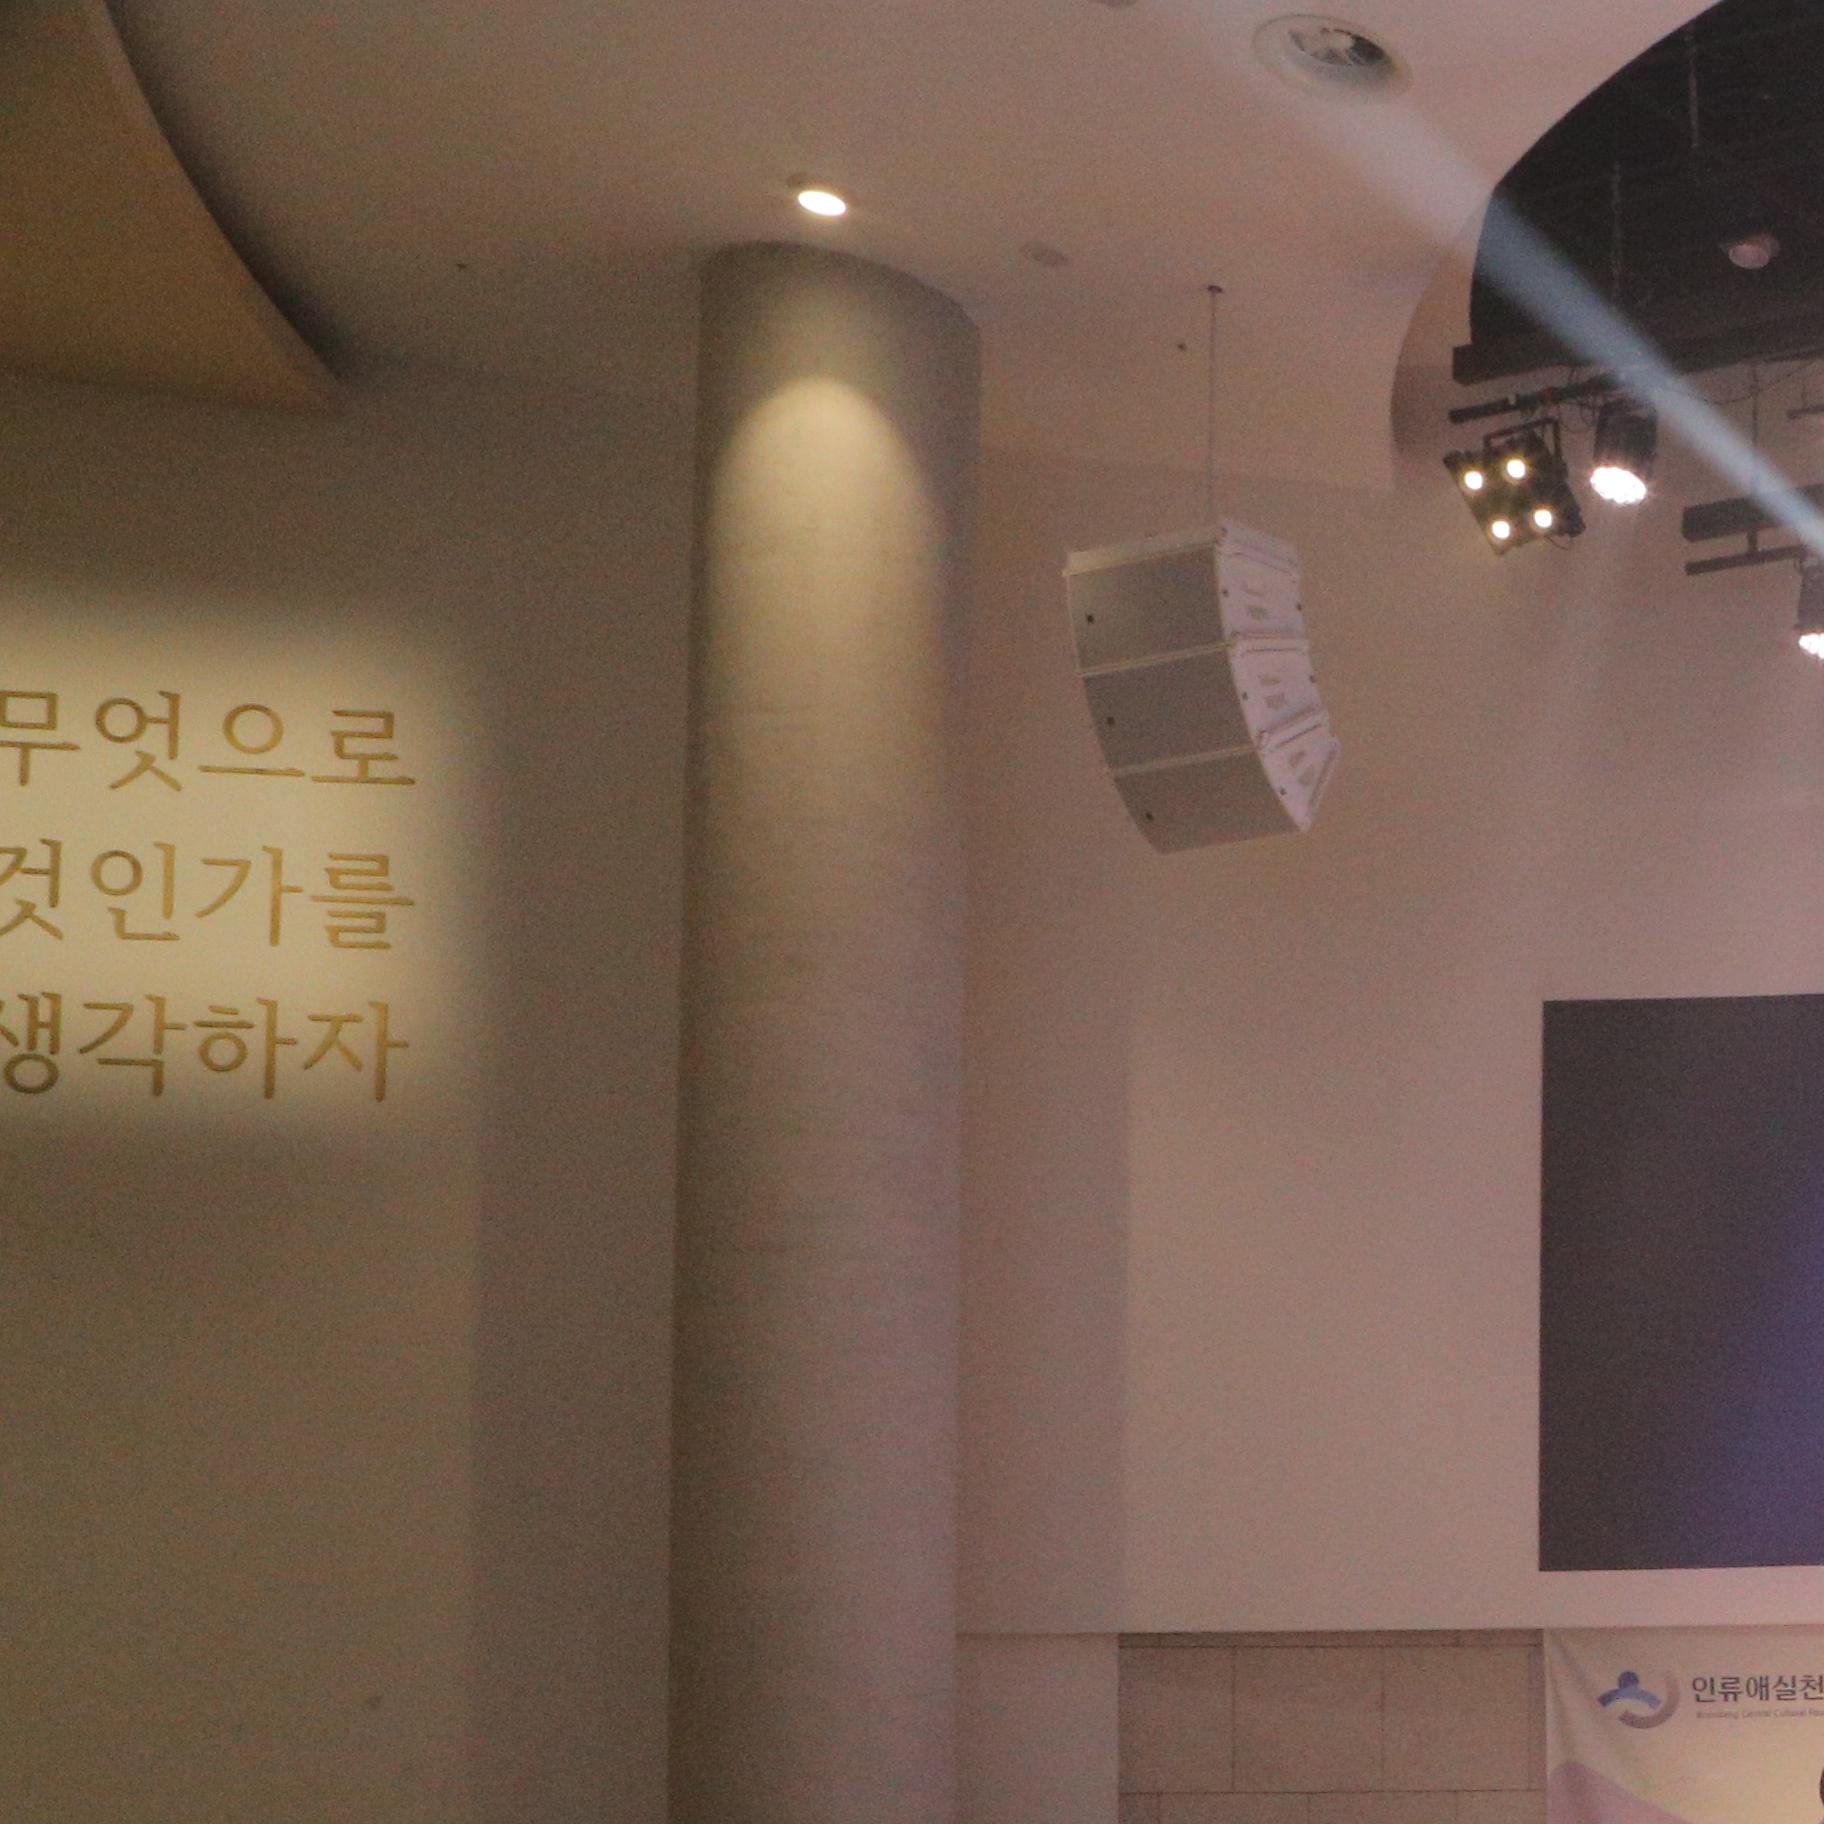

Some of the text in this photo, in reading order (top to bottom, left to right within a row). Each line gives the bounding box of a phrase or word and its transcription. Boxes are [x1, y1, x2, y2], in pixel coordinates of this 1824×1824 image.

[0, 690, 415, 792] 무엇으로
[0, 838, 415, 950] 것인가를
[0, 991, 410, 1102] 생각하자
